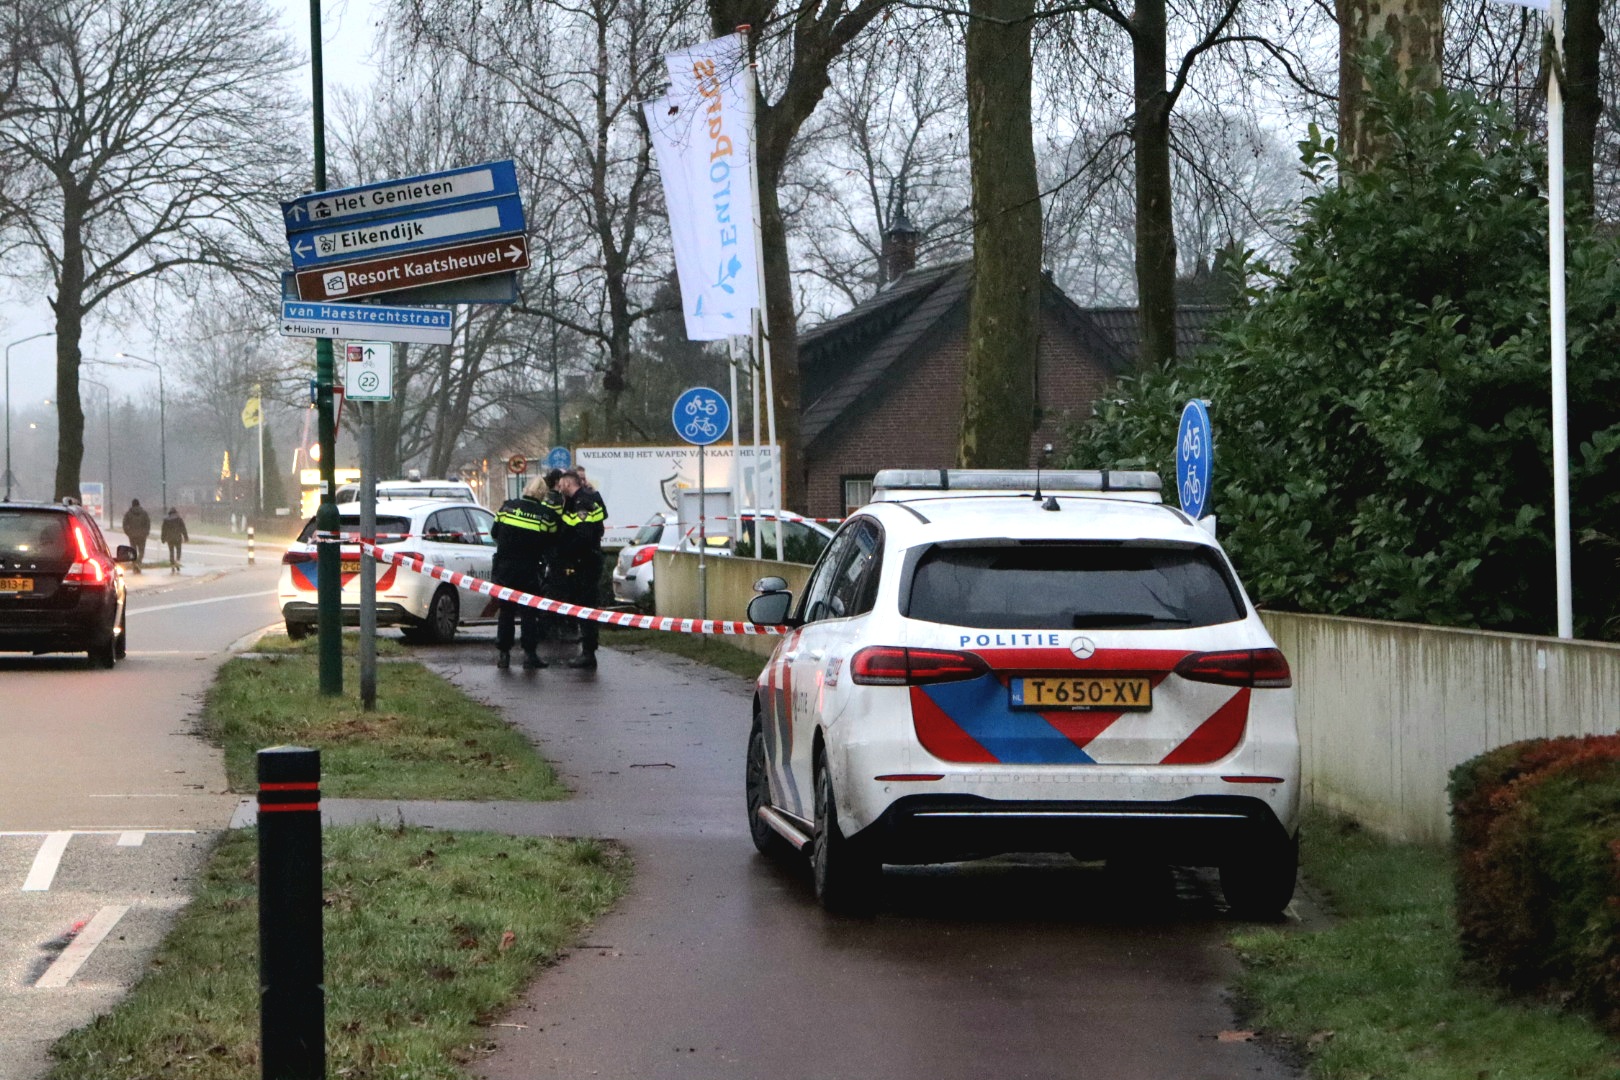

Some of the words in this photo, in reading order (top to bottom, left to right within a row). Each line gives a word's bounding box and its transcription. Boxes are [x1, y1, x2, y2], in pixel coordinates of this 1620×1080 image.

[335, 193, 363, 212] Het
[372, 180, 453, 205] Genieten
[341, 222, 424, 248] Eikendijk
[347, 266, 400, 287] Resort
[404, 248, 501, 279] Kaatsheuvel
[289, 306, 313, 317] van
[321, 307, 445, 325] Haestrechtstraat
[293, 325, 327, 335] Huisnr.
[332, 327, 339, 335] 11
[362, 377, 376, 387] 22
[583, 451, 621, 459] WELKOM
[623, 451, 635, 459] BIJ
[655, 450, 687, 458] WAPEN
[960, 633, 1060, 647] POLITIE
[1032, 681, 1143, 703] T-650-XV
